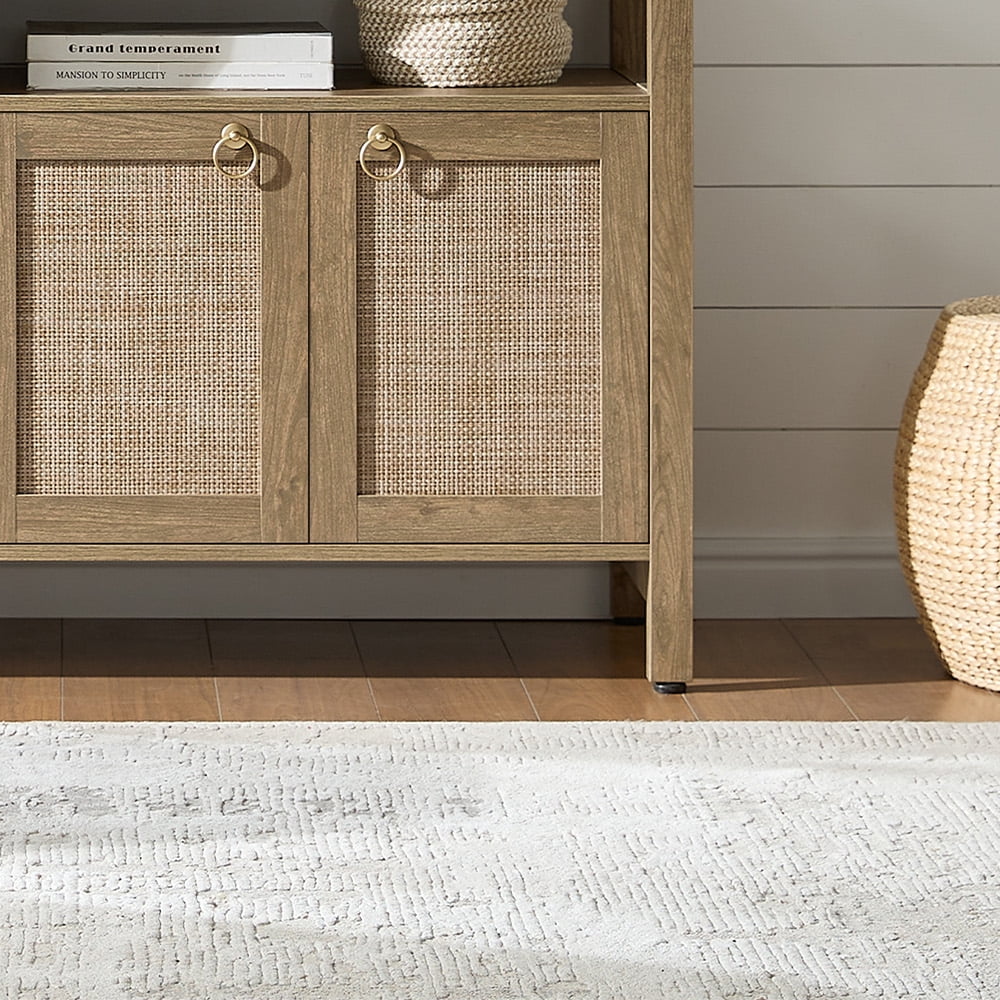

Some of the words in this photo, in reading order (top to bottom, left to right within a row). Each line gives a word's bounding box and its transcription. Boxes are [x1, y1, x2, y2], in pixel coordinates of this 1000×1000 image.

[68, 43, 114, 53] Grand
[119, 43, 221, 54] temperament
[56, 71, 99, 79] MANSION
[101, 71, 115, 79] TO
[116, 71, 167, 80] SIMPLICITY
